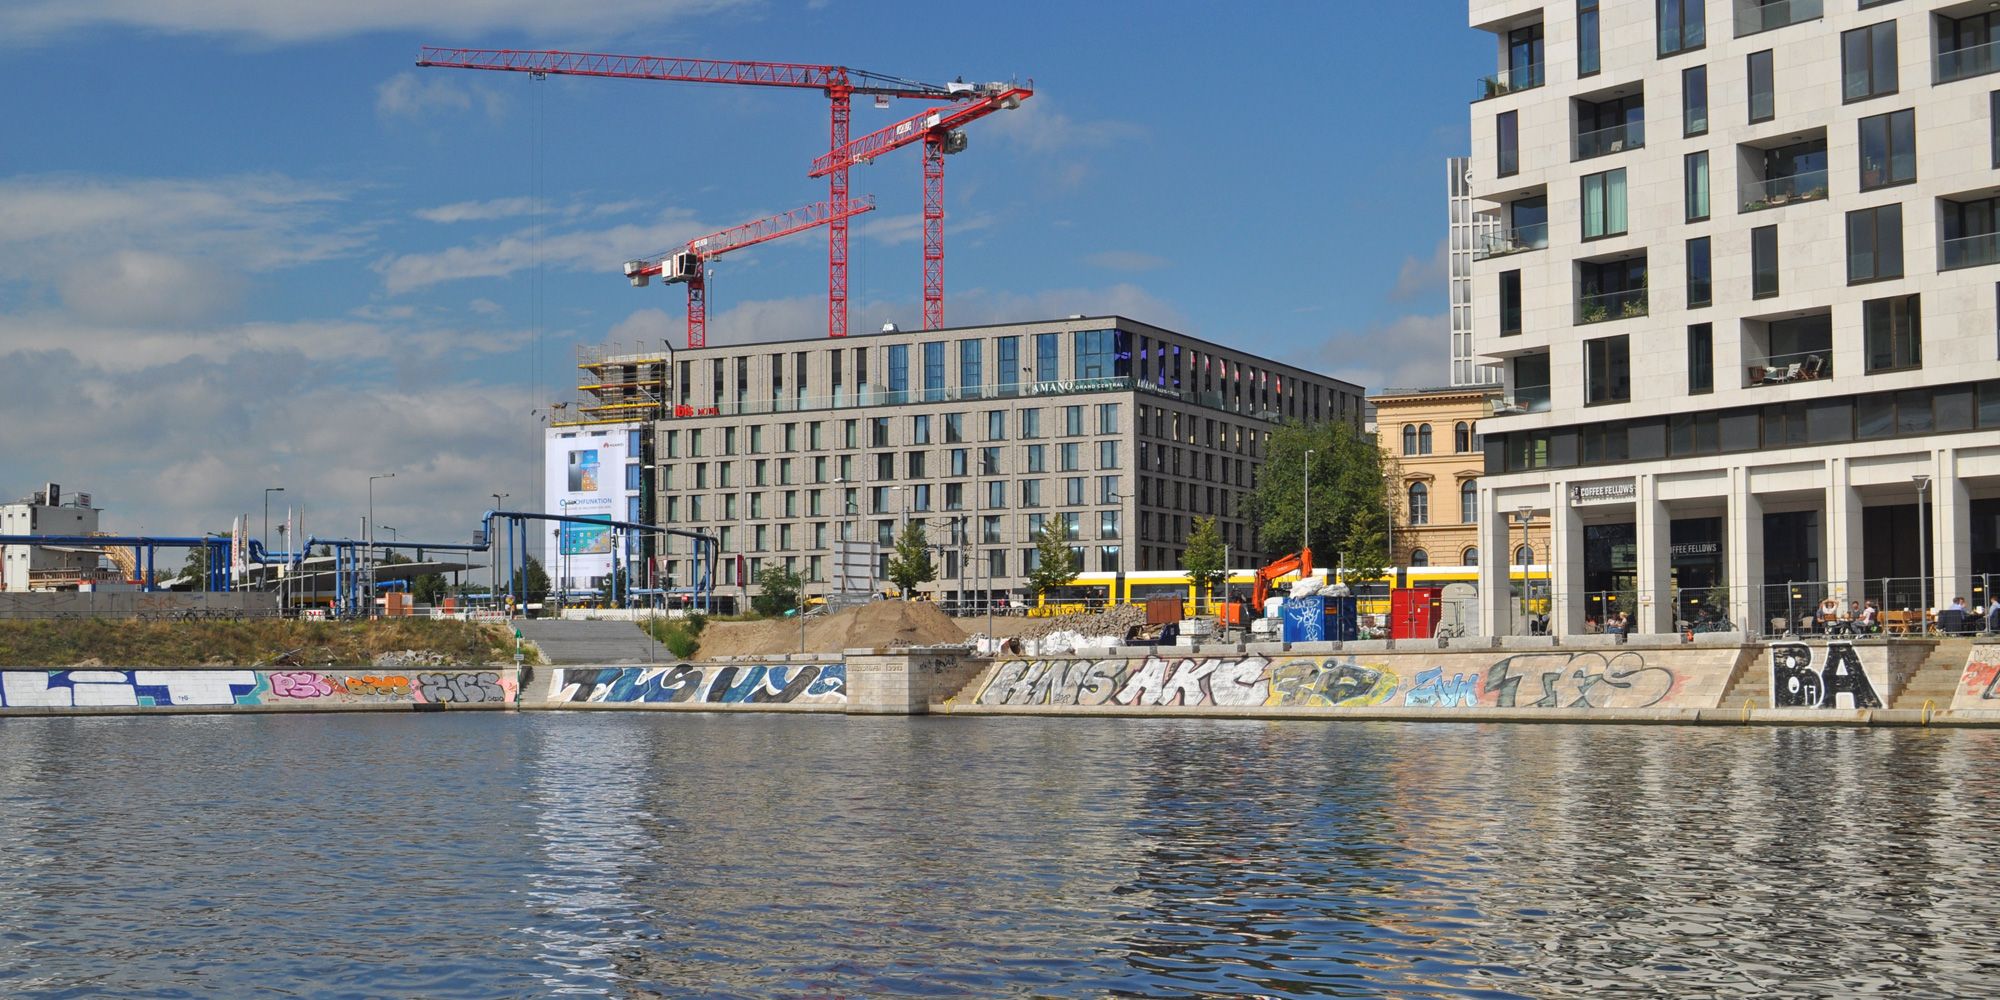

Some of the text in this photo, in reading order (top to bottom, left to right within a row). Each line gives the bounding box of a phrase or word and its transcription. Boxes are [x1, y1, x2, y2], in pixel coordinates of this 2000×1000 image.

[1033, 381, 1073, 393] AMANO
[1580, 484, 1634, 497] COFFEE FELLOWS
[1688, 544, 1717, 553] FELLOWS
[1769, 641, 1886, 709] BA
